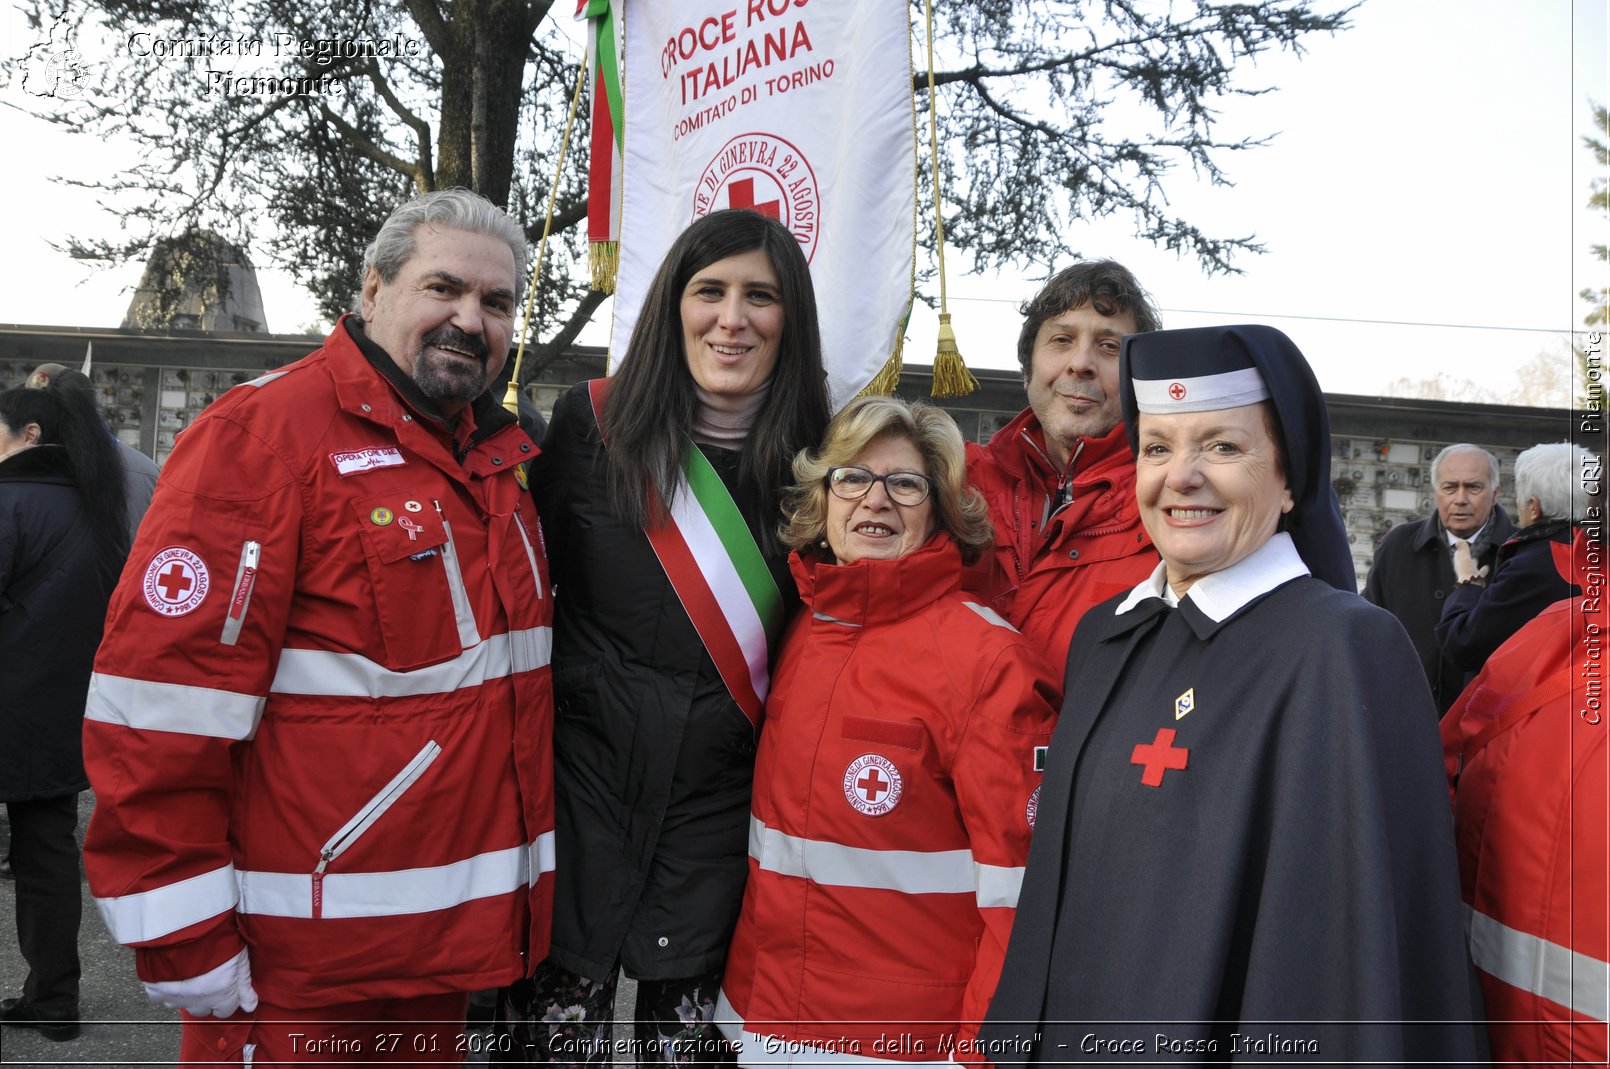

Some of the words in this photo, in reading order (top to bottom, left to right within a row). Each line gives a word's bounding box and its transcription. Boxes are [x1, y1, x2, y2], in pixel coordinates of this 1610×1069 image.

[661, 9, 737, 79] CROCE
[681, 20, 813, 106] ITALIANA
[674, 95, 737, 141] COMITATO
[741, 84, 757, 105] DI
[765, 59, 834, 96] TORINO
[705, 169, 719, 192] DI
[720, 140, 777, 175] GINEVRA
[776, 154, 798, 179] 22
[788, 176, 814, 244] AGOSTO
[156, 556, 164, 565] DI
[163, 549, 194, 563] GINEVRA
[193, 560, 203, 572] 22
[145, 563, 165, 611] CONVENZIONE
[191, 572, 208, 606] AGOSTO
[174, 603, 192, 614] 1864
[854, 760, 863, 770] DI
[862, 755, 892, 771] GINEVRA
[889, 767, 900, 778] 22
[844, 765, 866, 812] CONVENZIONE
[888, 778, 902, 804] AGOSTO
[872, 803, 890, 815] 1864
